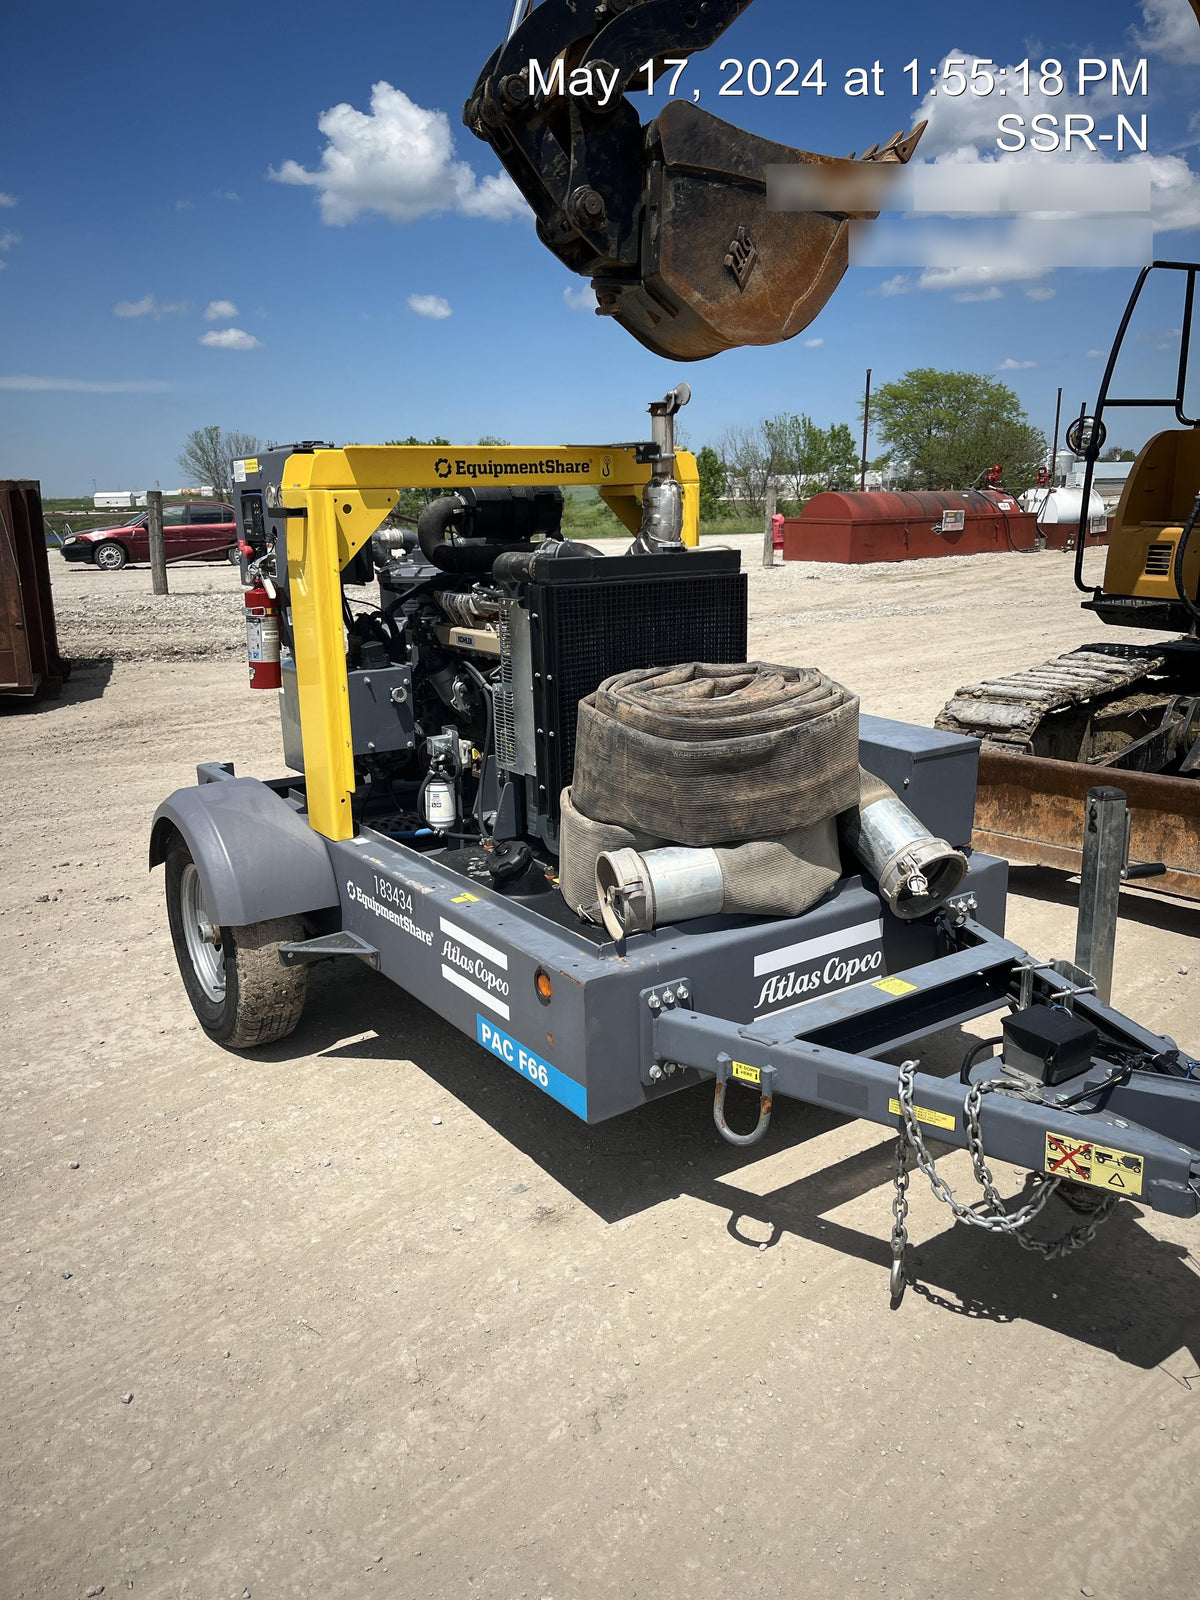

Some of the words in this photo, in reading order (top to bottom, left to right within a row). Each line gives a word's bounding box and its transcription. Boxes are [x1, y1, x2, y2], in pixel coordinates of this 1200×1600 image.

[455, 460, 590, 479] EquipmentShare
[355, 886, 434, 947] EquipmentShare
[373, 875, 413, 914] 183434
[441, 940, 474, 974] Atlas
[474, 959, 510, 996] Copco
[753, 971, 821, 1009] Atlas
[823, 951, 882, 984] Copco
[481, 1022, 514, 1062] PAC
[518, 1049, 549, 1087] F66
[743, 1065, 758, 1073] DOWN
